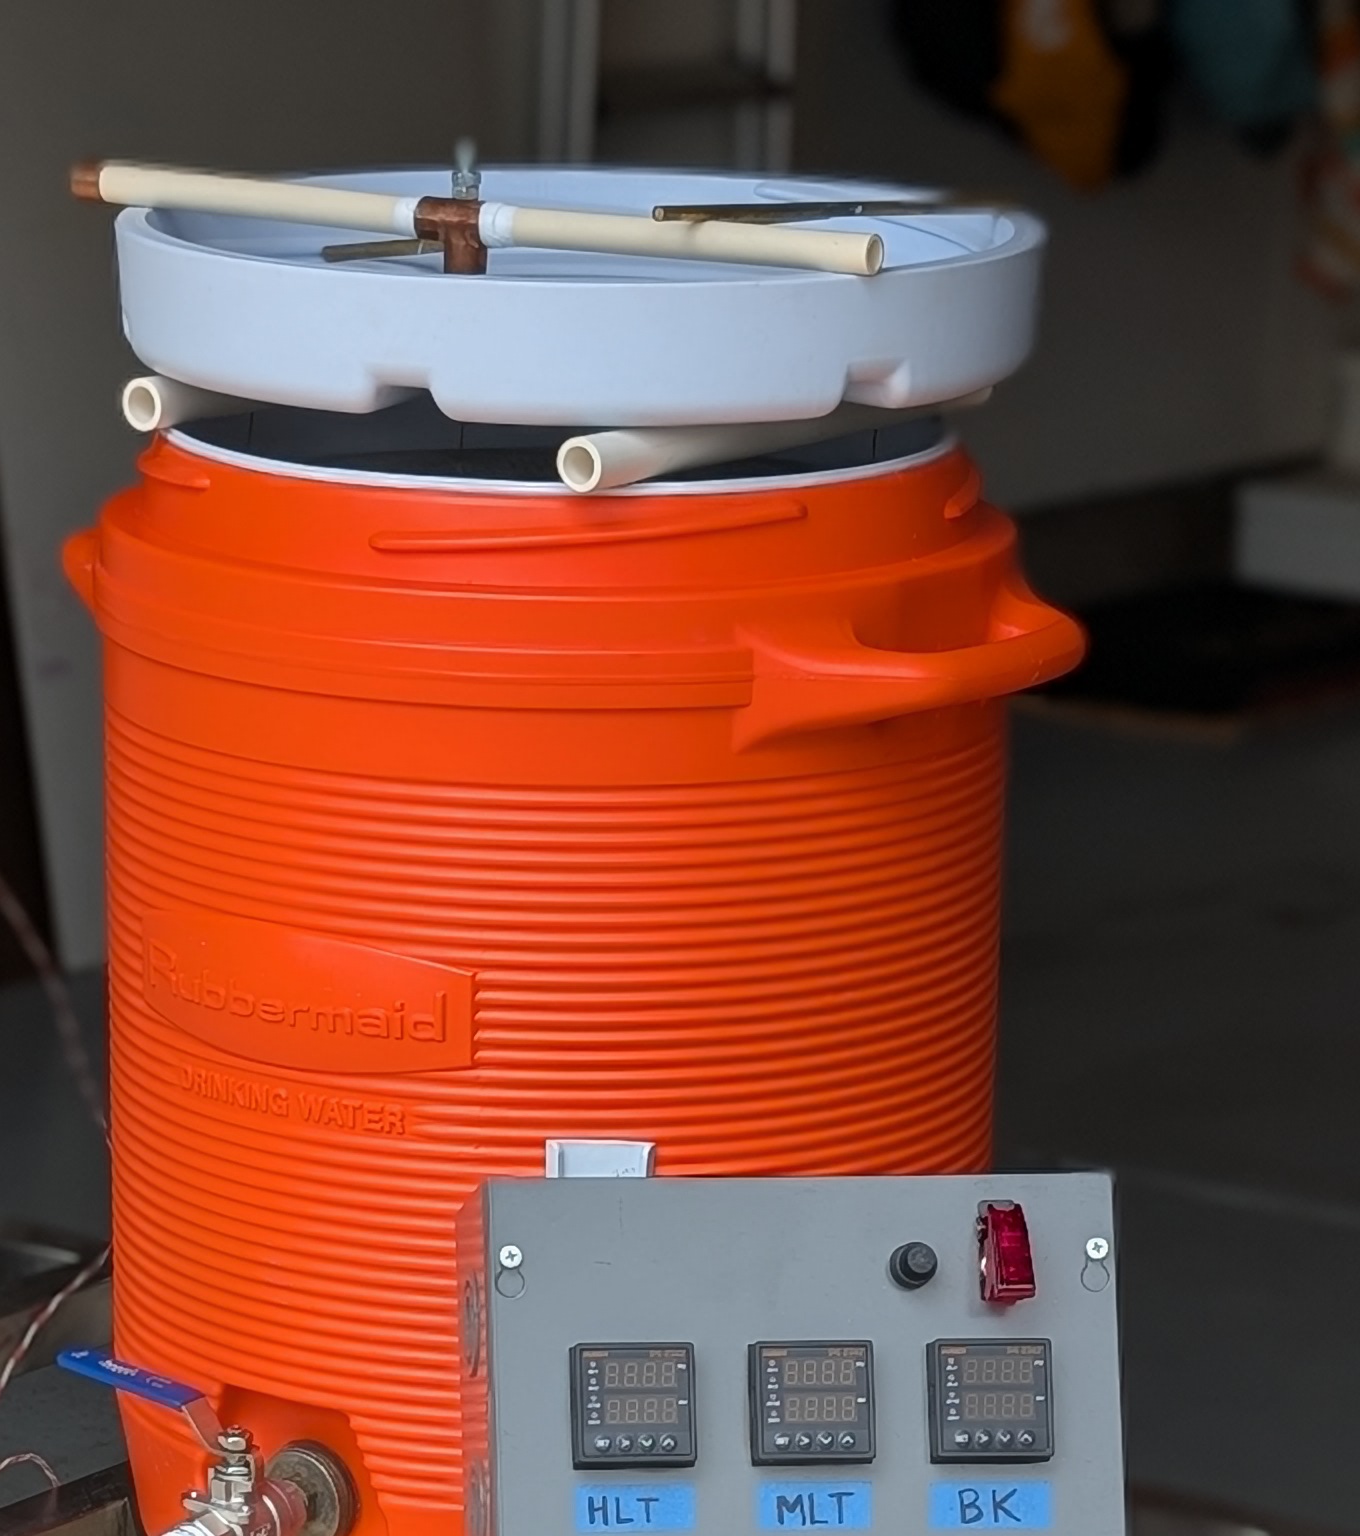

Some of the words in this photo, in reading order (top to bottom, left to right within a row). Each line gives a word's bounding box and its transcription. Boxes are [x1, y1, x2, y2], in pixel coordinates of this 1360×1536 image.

[146, 943, 448, 1043] Rubbermaid
[178, 1065, 290, 1116] DRINKING
[299, 1093, 407, 1135] WATER
[586, 1496, 661, 1527] HLT
[776, 1491, 855, 1526] MLT
[958, 1489, 1023, 1524] BK
